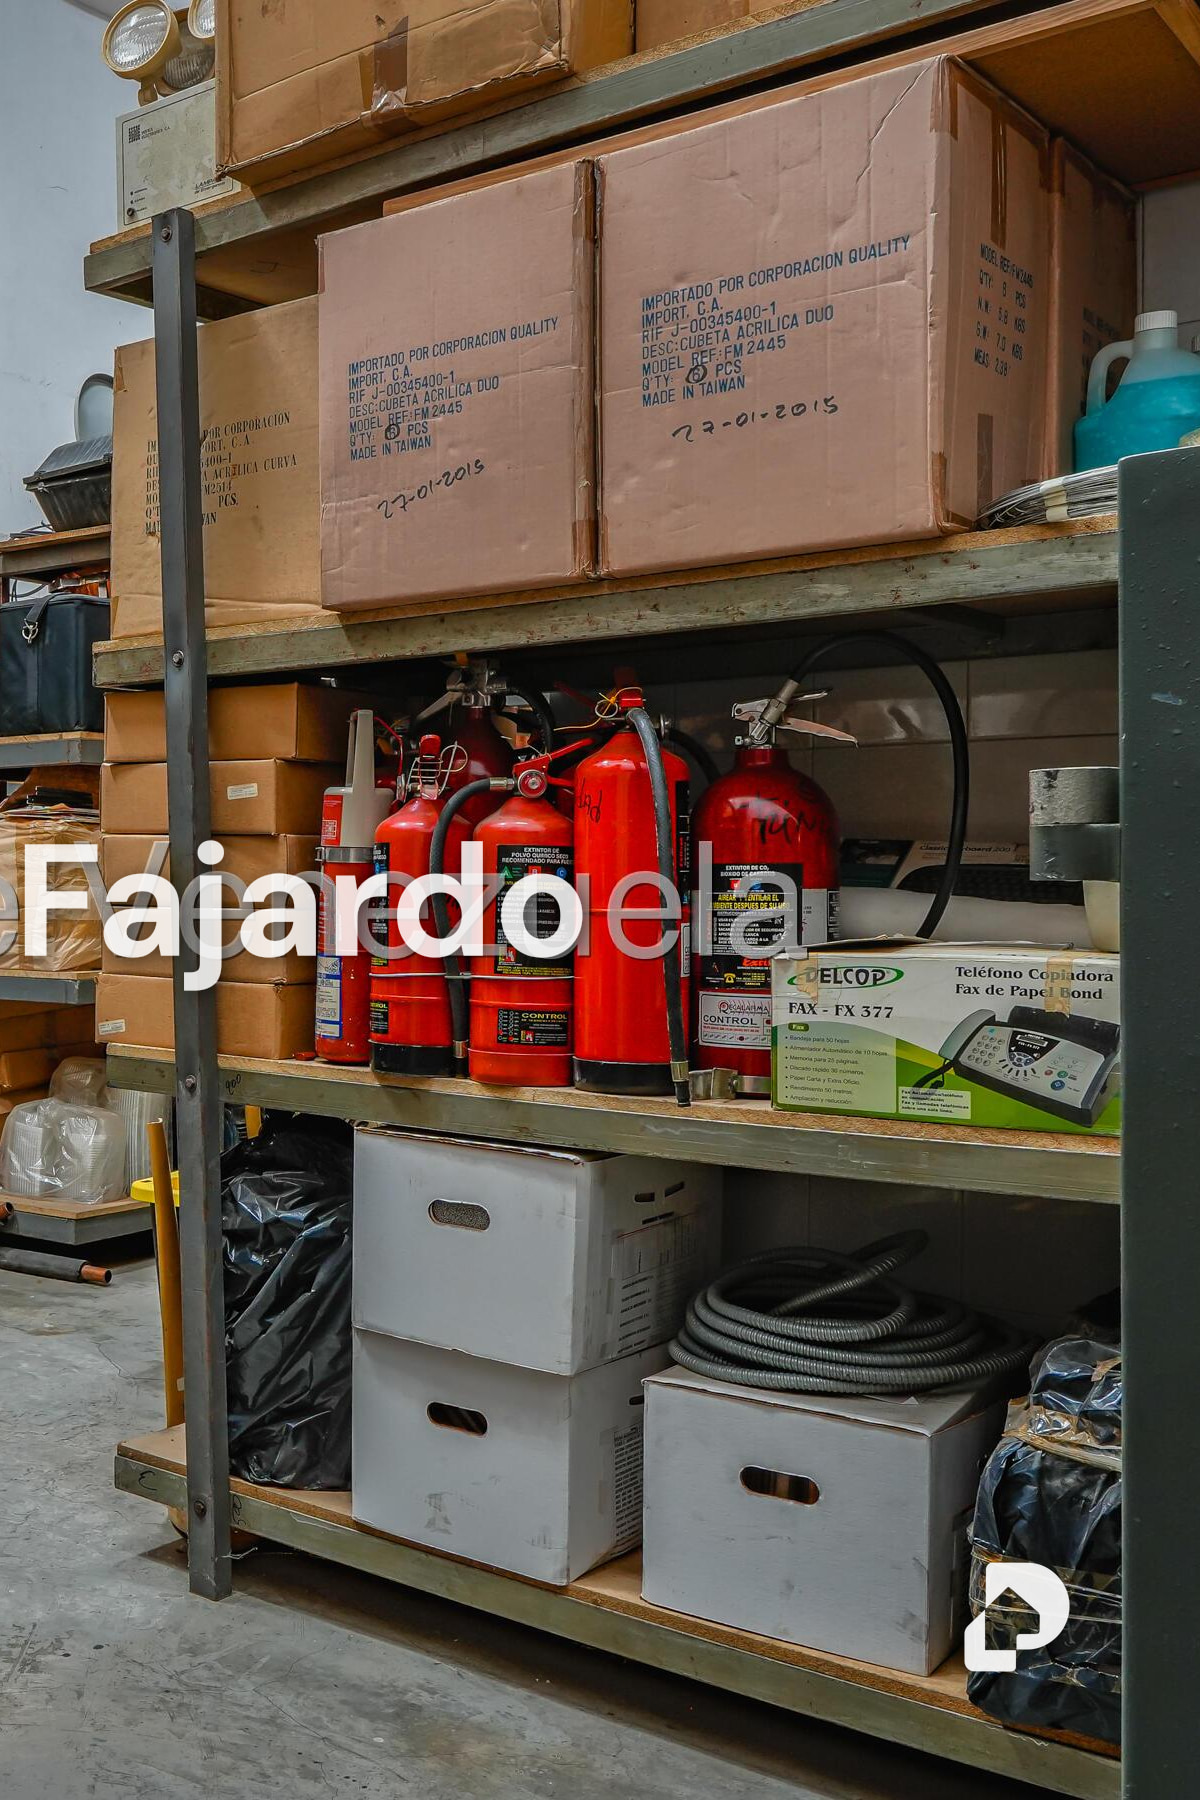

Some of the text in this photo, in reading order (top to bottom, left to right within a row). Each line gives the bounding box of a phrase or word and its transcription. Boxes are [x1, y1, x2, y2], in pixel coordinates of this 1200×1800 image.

[642, 234, 911, 312] IMPORTADO POR CORPORACION QUALITY
[697, 297, 724, 317] C.A.
[642, 301, 776, 344] RIF J-00345400-1
[737, 313, 799, 340] ACRILICA
[805, 305, 834, 326] DUO
[348, 316, 559, 376] IMPORTADO POR CORPORACION QUALITY
[642, 334, 786, 378] MODEL 2445
[392, 364, 413, 382] C.A.
[715, 359, 742, 378] PCS
[349, 370, 455, 405] RIF J-00345400-1
[423, 381, 473, 405] ACRILICA
[477, 375, 500, 393] DUO
[642, 375, 745, 407] MADE IN TAIWAN
[202, 411, 291, 440] POR CORPORACION
[349, 402, 463, 434] MODEL 2445
[407, 420, 429, 436] PCS
[350, 435, 431, 462] MADE IN TAIWAN
[212, 461, 258, 480] ACRILICA
[263, 453, 297, 472] CURVA
[954, 966, 1114, 982] Teléfono Copiadora
[955, 984, 1103, 999] Fax de Papel Bond
[521, 1012, 568, 1020] CONTROL
[703, 1014, 758, 1026] CONTROL
[788, 1002, 894, 1018] FAX FX 377
